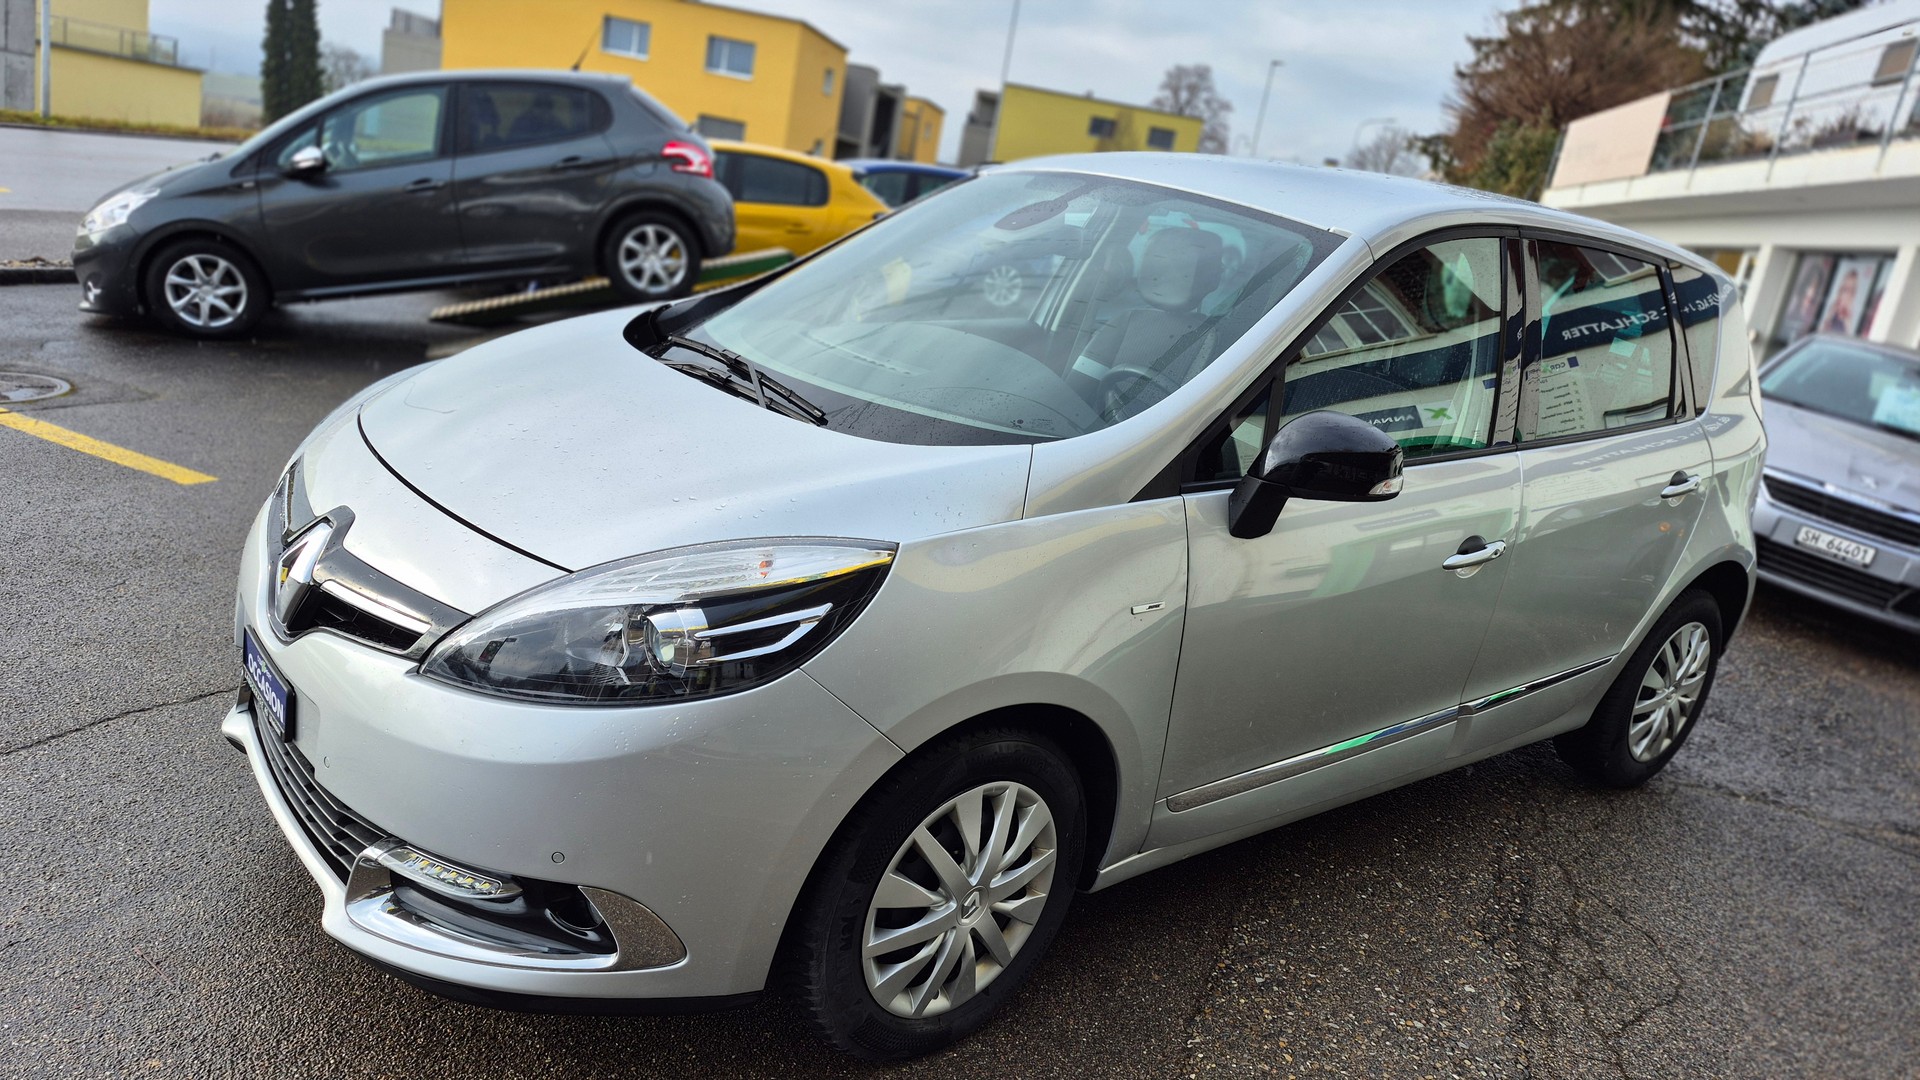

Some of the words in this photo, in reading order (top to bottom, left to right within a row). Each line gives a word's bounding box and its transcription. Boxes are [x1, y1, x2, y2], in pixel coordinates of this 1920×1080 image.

[1801, 530, 1821, 545] SH
[1826, 535, 1869, 560] 64401
[247, 653, 284, 723] OCCASION
